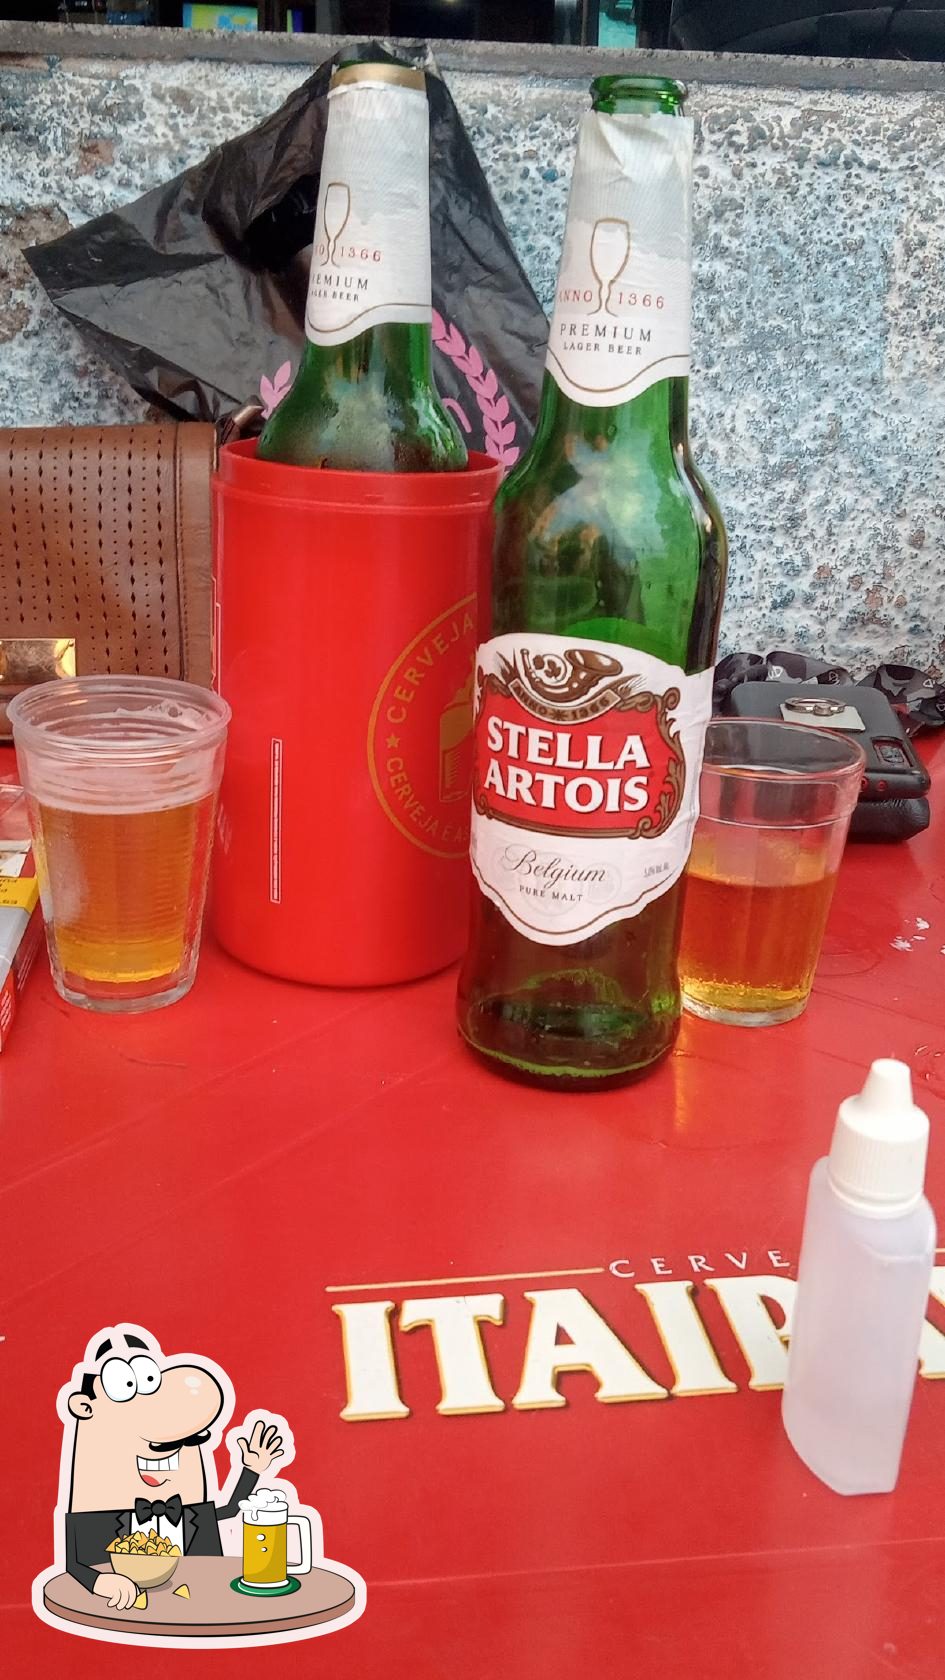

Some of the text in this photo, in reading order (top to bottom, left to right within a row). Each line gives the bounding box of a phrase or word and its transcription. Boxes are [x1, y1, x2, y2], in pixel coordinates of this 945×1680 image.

[341, 246, 381, 262] 1366
[312, 273, 368, 290] EMIUM
[332, 290, 359, 302] BEER
[618, 291, 664, 310] 1366
[560, 323, 651, 342] PREMIUM
[563, 342, 642, 356] LAGER BEER
[386, 612, 474, 724] CERVEJA
[487, 716, 651, 770] STELLA
[386, 757, 440, 838] CERVEJA
[483, 759, 650, 813] ARTOIS
[500, 844, 606, 889] Belgium
[519, 885, 584, 902] PURE MALT
[609, 1250, 791, 1278] CERVE
[332, 1266, 945, 1422] ITAIP
